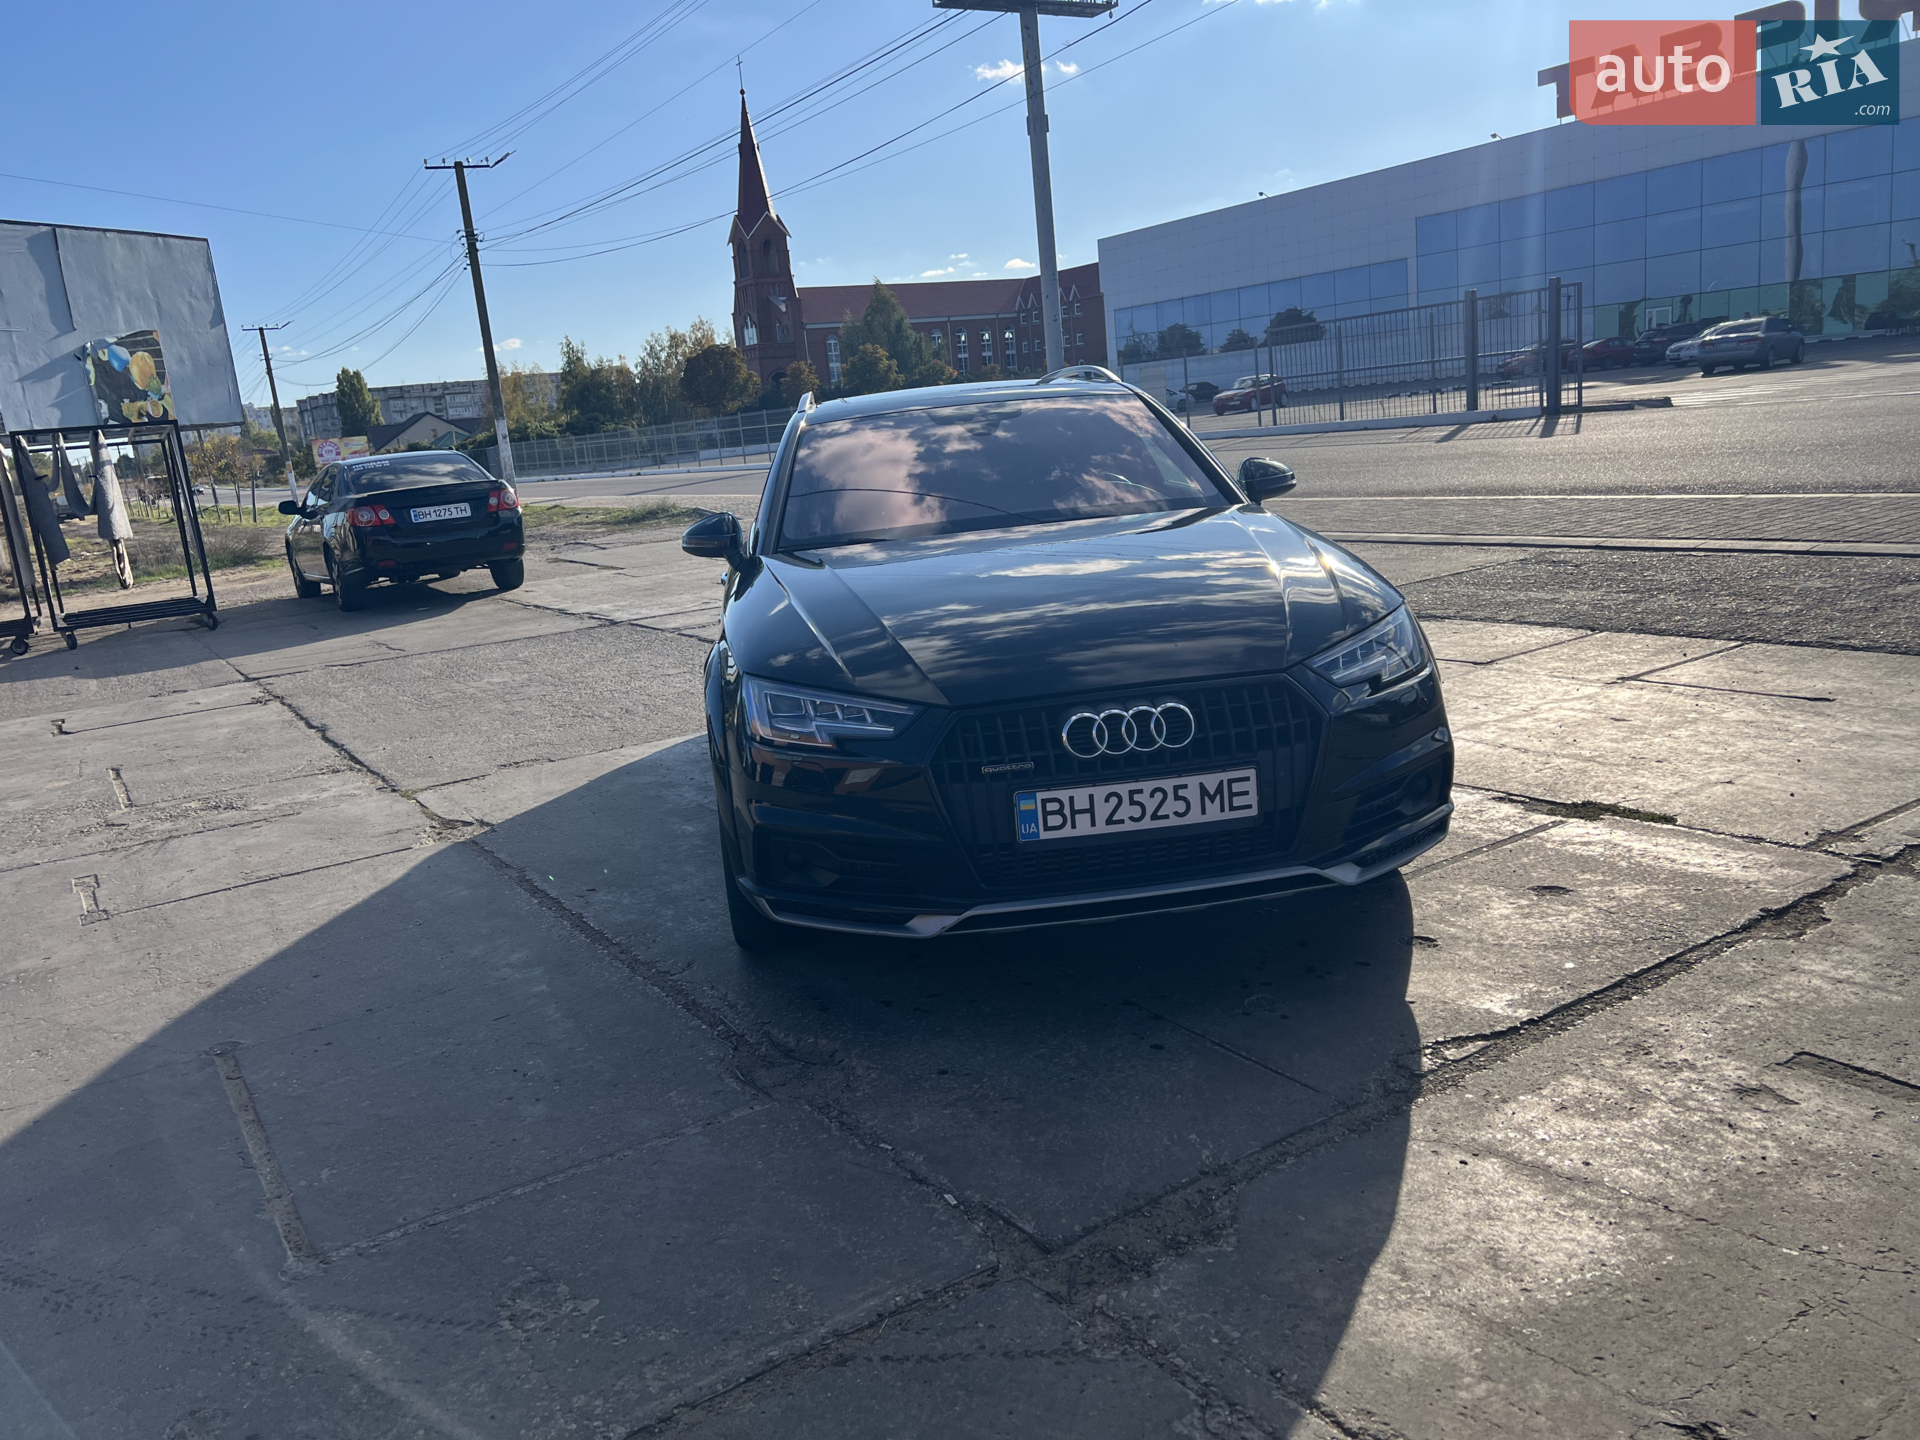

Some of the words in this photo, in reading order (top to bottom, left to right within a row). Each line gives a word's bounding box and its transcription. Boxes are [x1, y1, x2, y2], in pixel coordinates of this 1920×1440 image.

[417, 510, 431, 520] BH
[433, 507, 453, 518] 1275
[454, 506, 467, 515] TH
[984, 763, 1032, 774] quattro
[1041, 794, 1096, 832] BH
[1104, 784, 1191, 826] 2525
[1199, 776, 1253, 815] ME
[1021, 822, 1038, 834] UA
